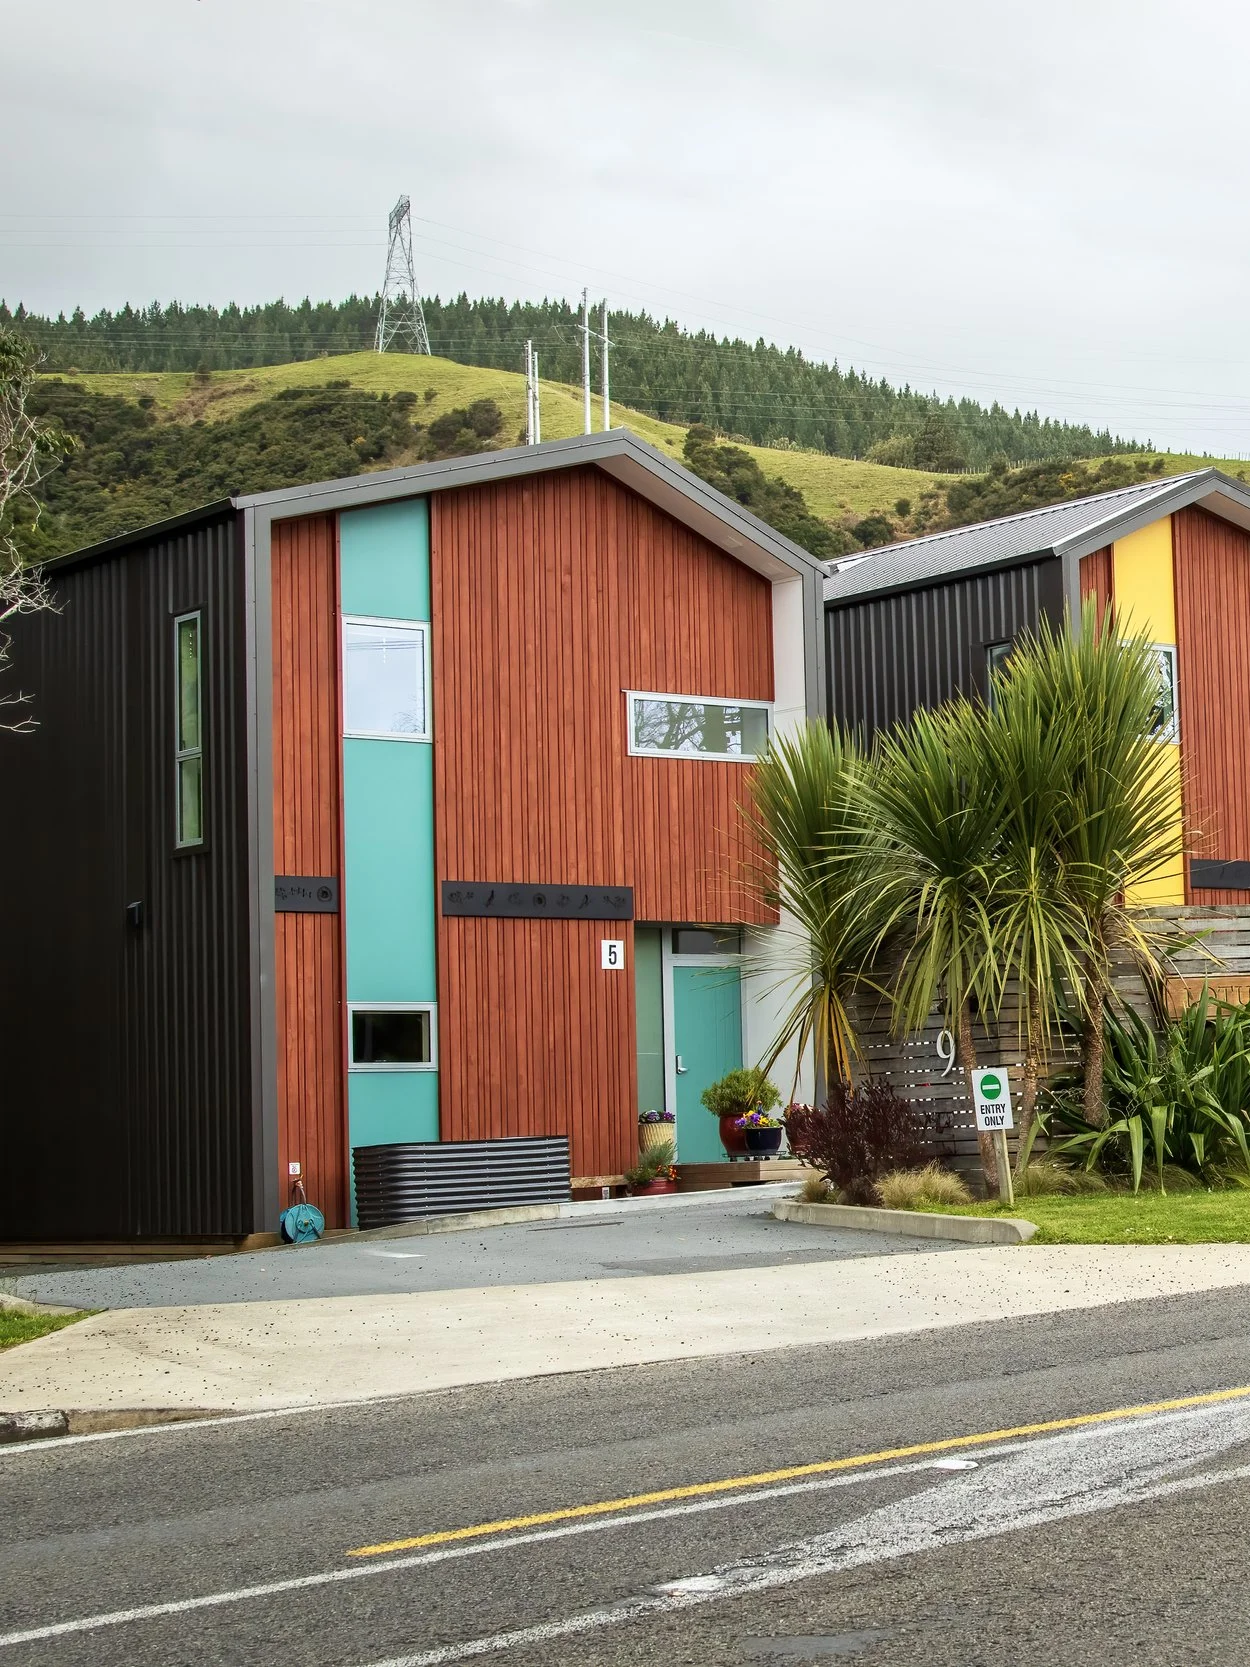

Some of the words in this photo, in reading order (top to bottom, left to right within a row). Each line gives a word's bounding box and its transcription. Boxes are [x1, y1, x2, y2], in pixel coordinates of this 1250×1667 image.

[608, 944, 618, 966] 5
[936, 1030, 955, 1077] 9
[980, 1104, 1005, 1114] ENTRY
[985, 1116, 1004, 1126] ONLY
